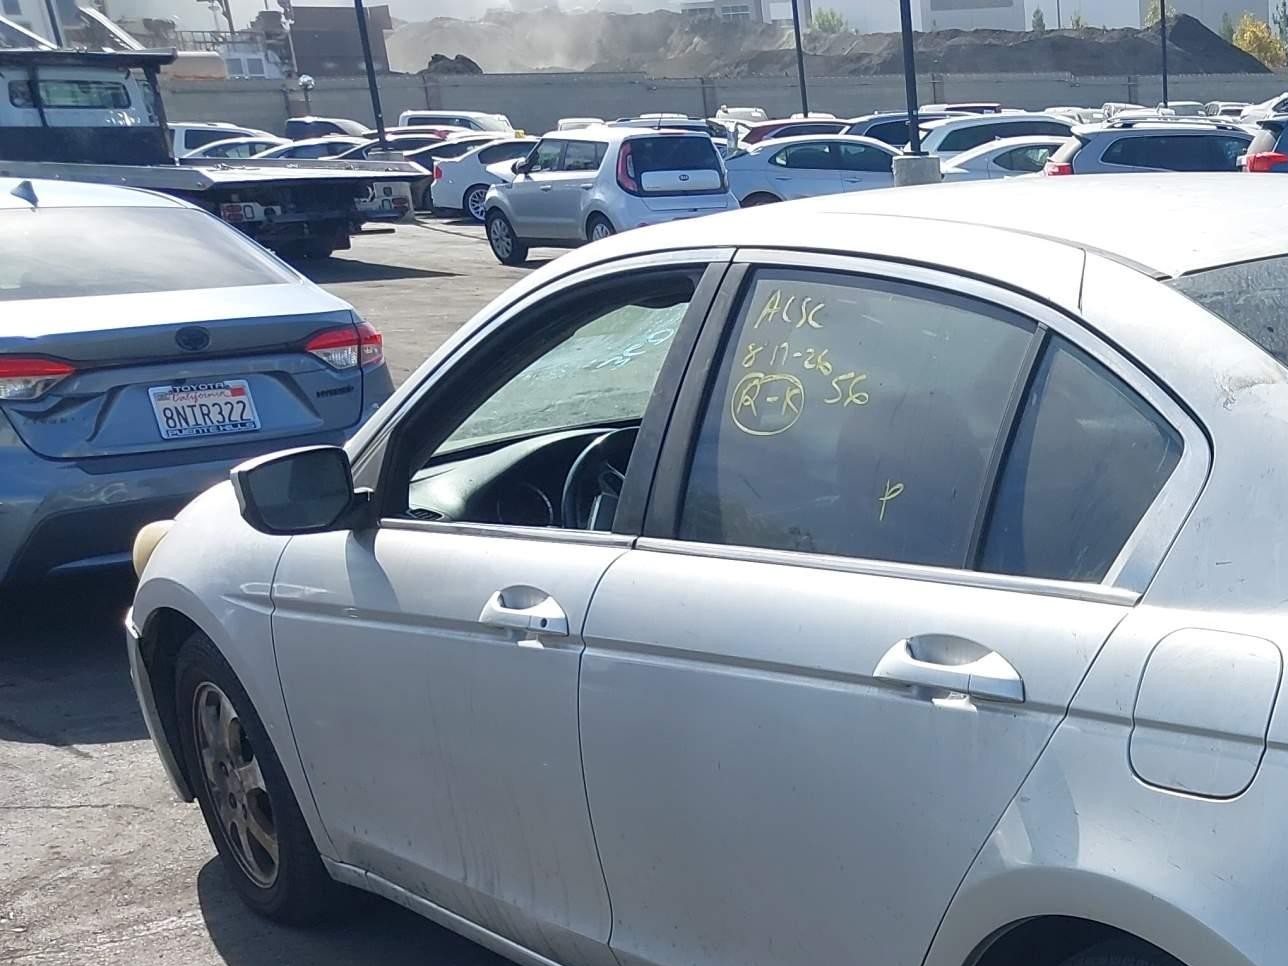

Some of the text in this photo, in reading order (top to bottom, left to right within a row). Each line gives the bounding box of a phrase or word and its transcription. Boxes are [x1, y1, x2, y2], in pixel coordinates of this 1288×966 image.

[754, 289, 825, 329] ACSC
[173, 383, 224, 393] TOYOTA
[824, 371, 869, 407] 56
[163, 400, 251, 429] 8NIR322
